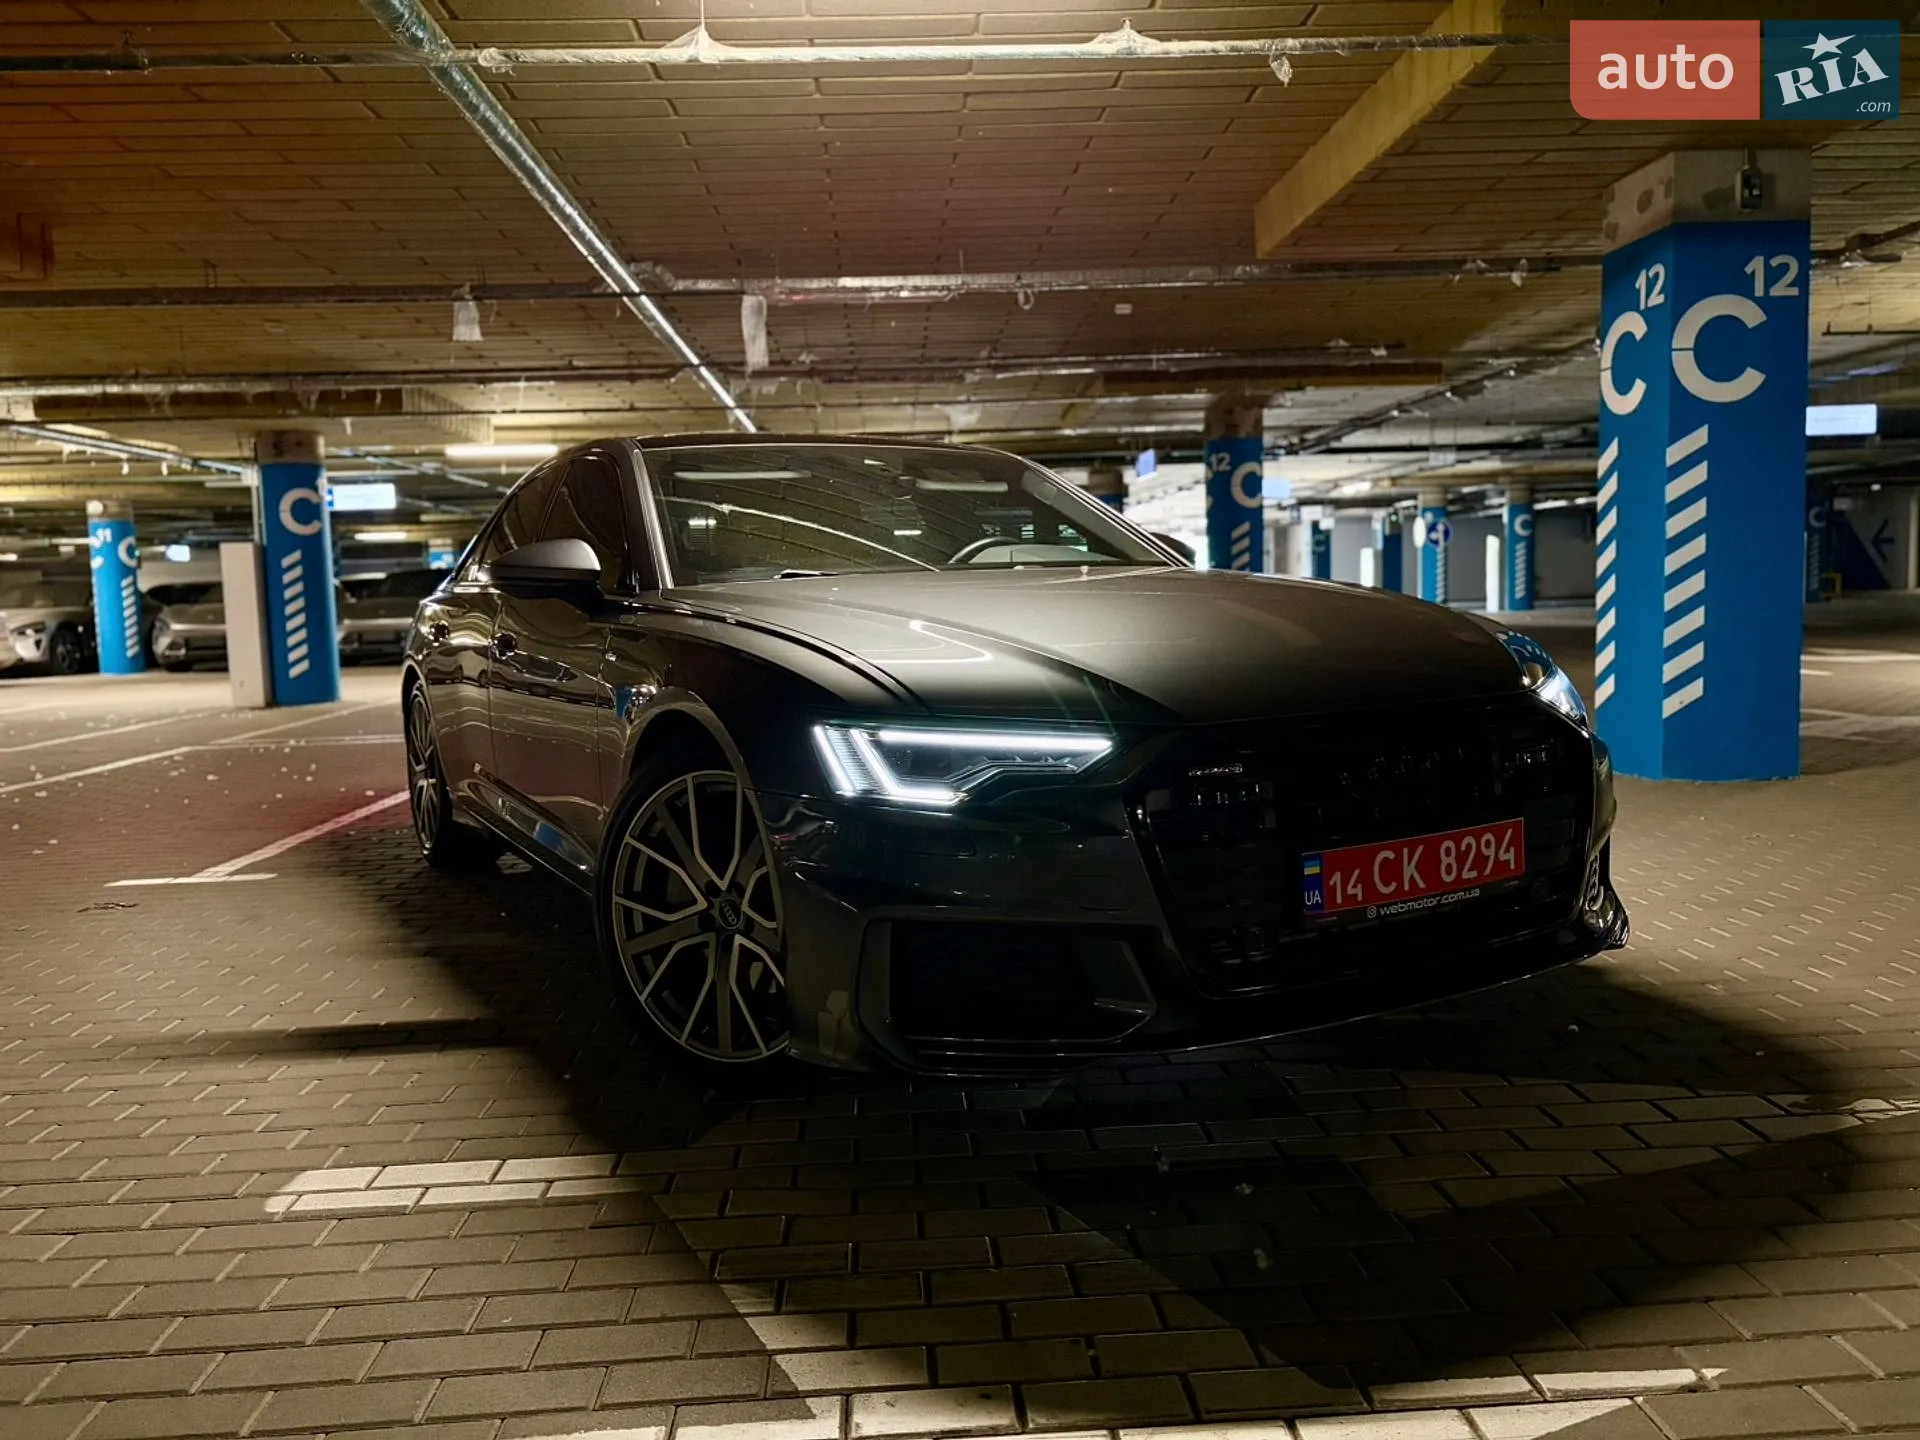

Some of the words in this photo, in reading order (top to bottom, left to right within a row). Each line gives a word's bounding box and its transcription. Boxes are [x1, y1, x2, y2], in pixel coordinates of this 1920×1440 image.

[1635, 263, 1665, 310] 12
[1745, 255, 1799, 297] 12
[1601, 311, 1648, 415] C
[1671, 294, 1767, 403] C
[1209, 452, 1232, 471] 12
[1230, 461, 1263, 509] C
[279, 487, 322, 536] C
[1514, 514, 1533, 536] C
[1329, 868, 1363, 904] 14
[1373, 845, 1426, 894] CK
[1440, 828, 1516, 882] 8294
[1304, 889, 1322, 905] UA
[1380, 888, 1480, 915] webmotor.com.ua
